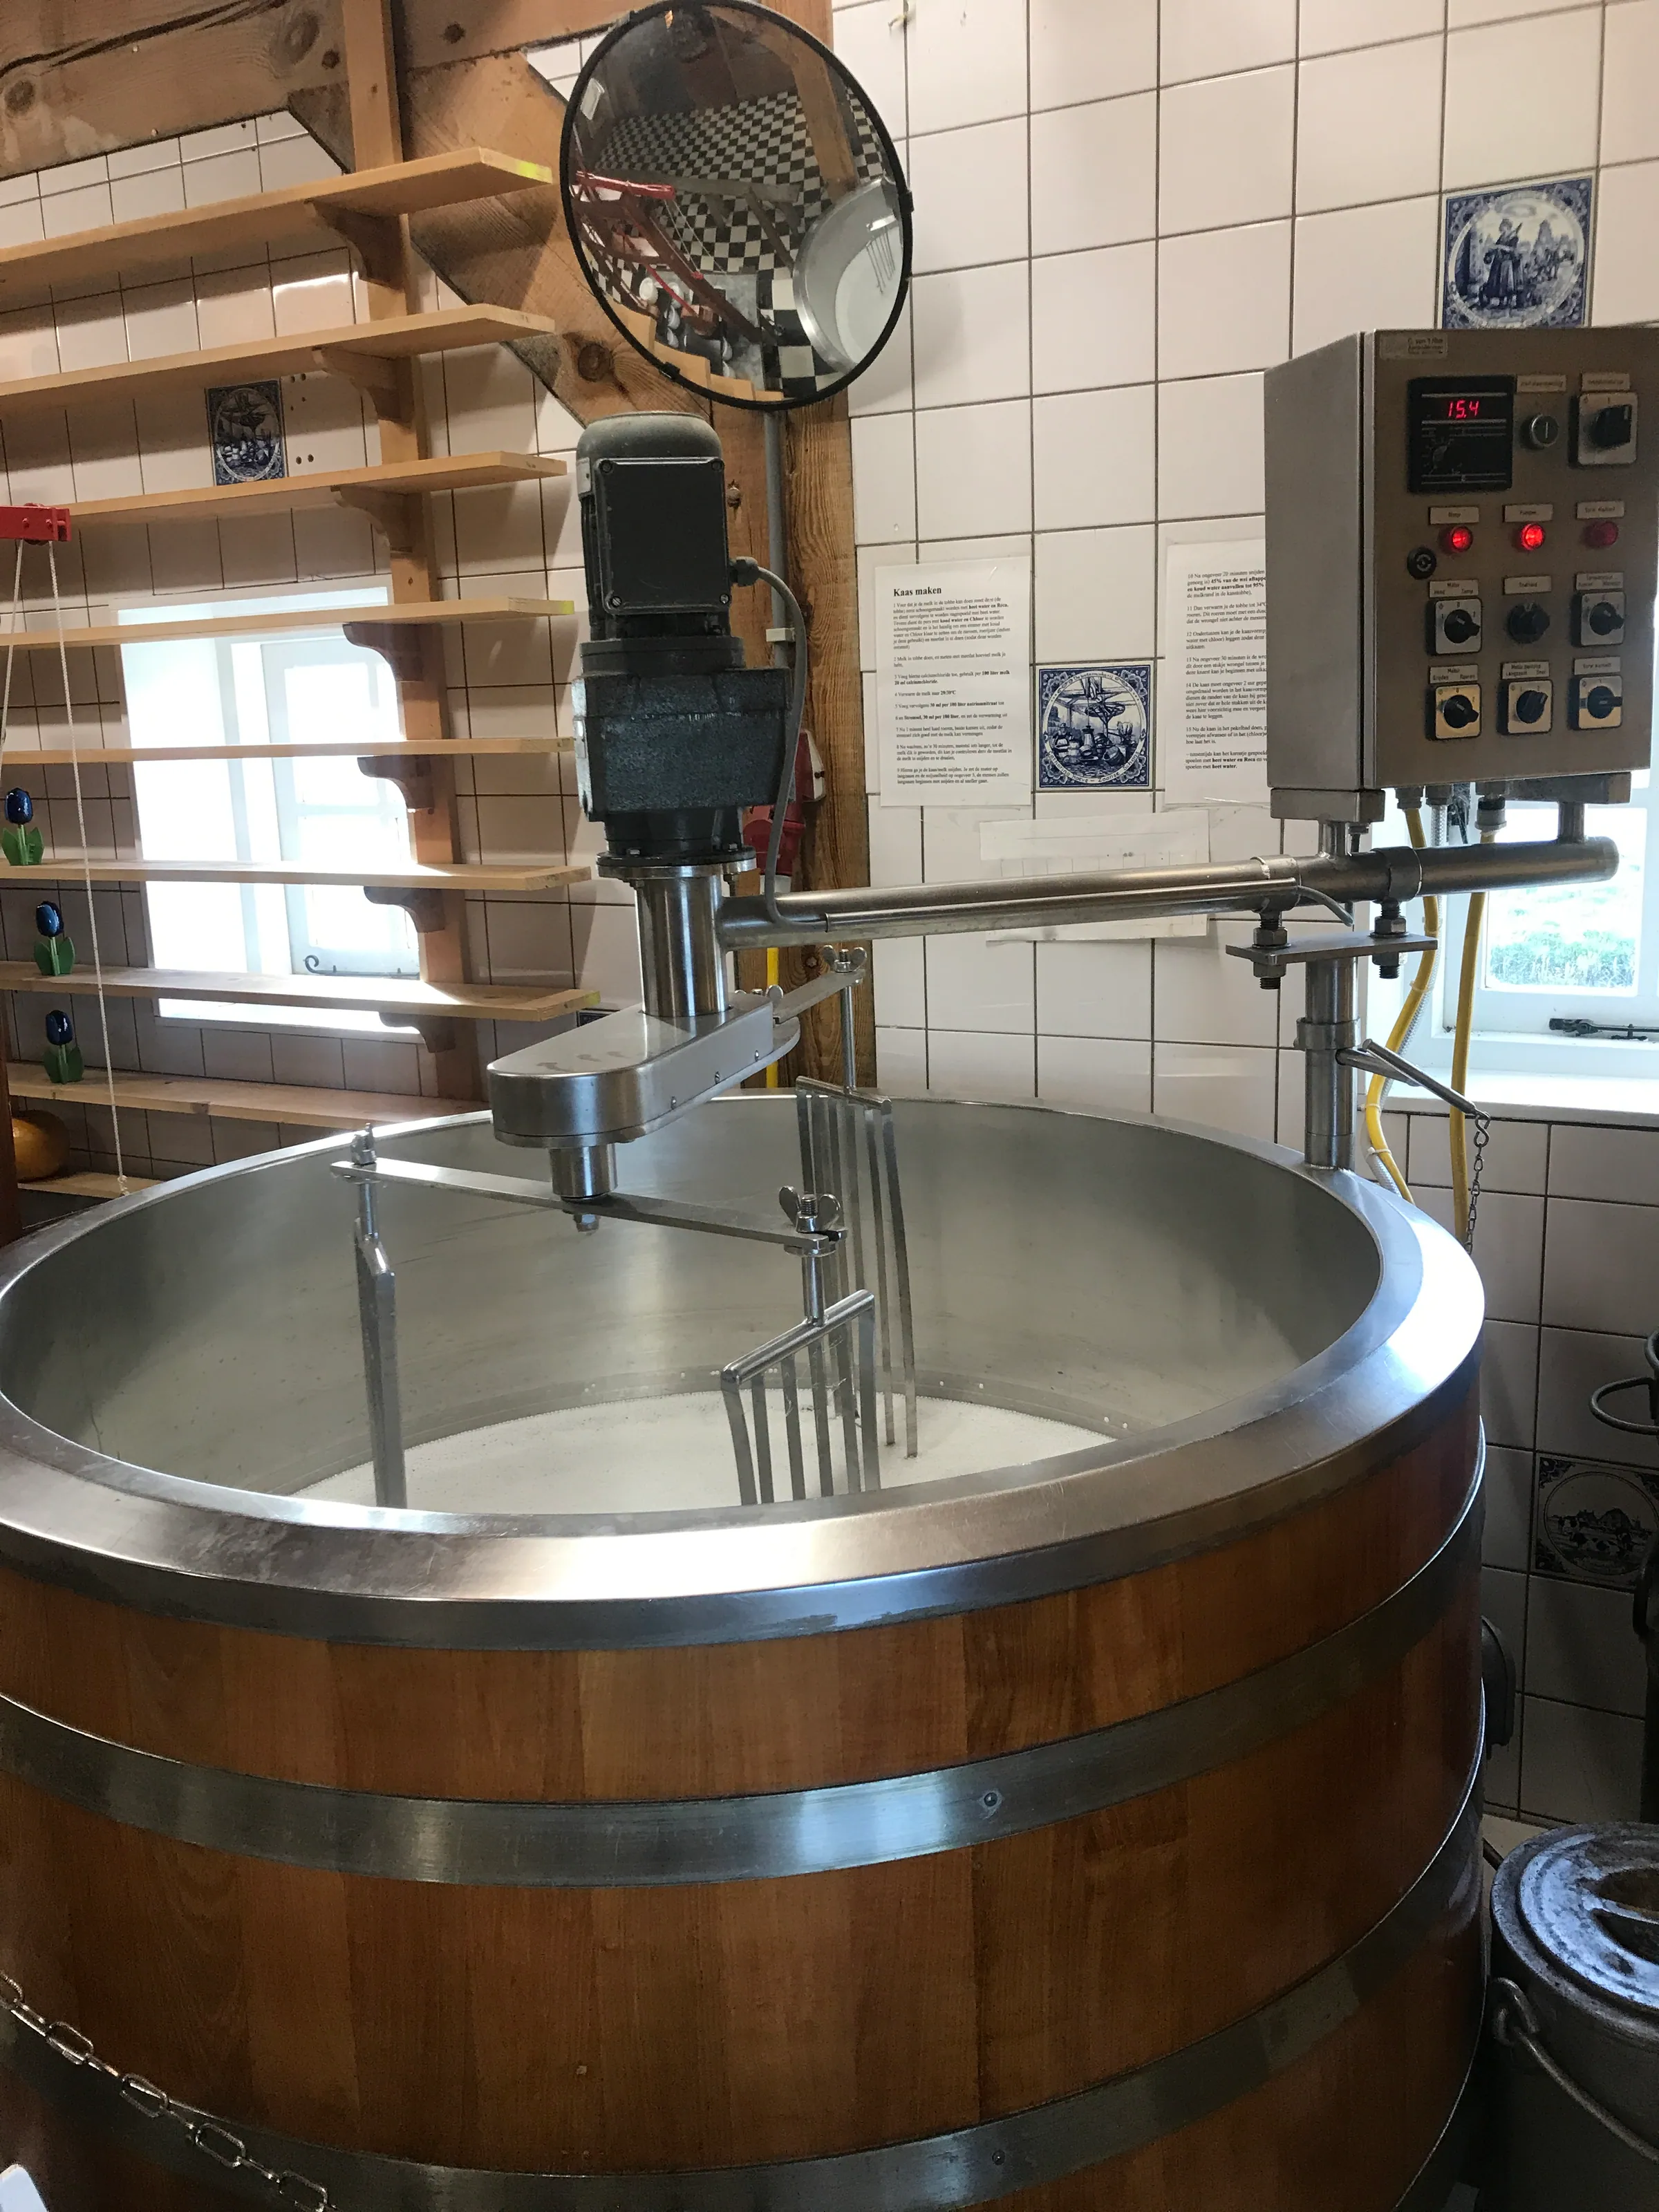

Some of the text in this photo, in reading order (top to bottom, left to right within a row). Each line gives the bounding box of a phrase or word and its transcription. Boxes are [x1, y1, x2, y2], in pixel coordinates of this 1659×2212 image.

[1448, 398, 1479, 419] 15.4
[915, 587, 941, 595] maken
[1098, 772, 1120, 782] Zaanse
